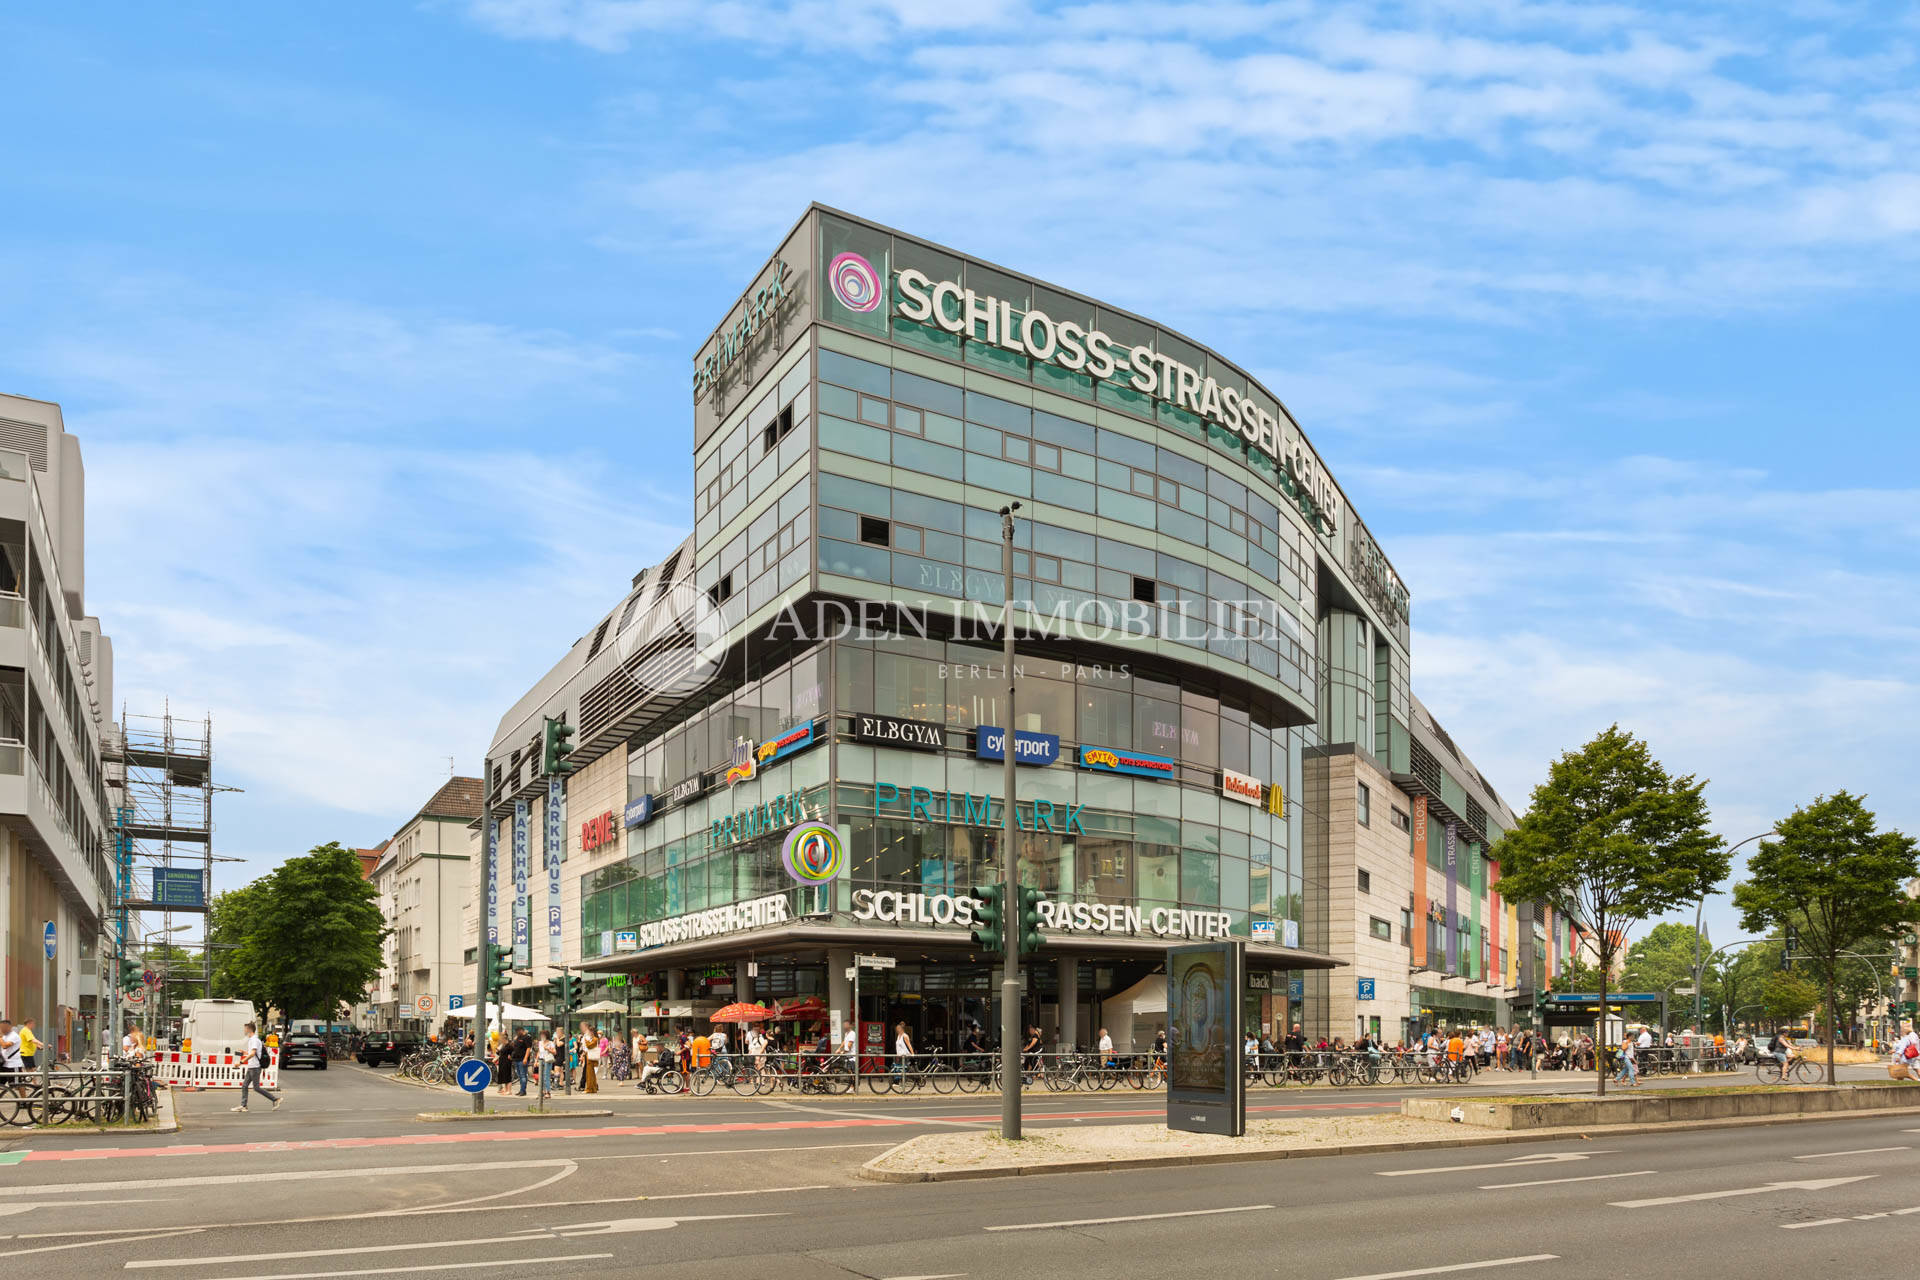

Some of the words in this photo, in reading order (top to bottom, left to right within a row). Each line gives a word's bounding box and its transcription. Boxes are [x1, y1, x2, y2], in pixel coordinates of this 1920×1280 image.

[897, 269, 1337, 532] SCHLOSS-STRASSEN-CENTER
[862, 717, 942, 746] ELBGYM
[1086, 751, 1117, 767] SMYTHS
[549, 782, 560, 894] PARKHAUS
[582, 810, 613, 852] REWE
[712, 786, 807, 849] PRIMARK
[1415, 798, 1425, 842] SCHLOSS
[516, 804, 526, 907] PARKHAUS
[1447, 824, 1456, 866] STRASSEN
[640, 894, 788, 947] SCHLOSS-STRASSEN-CENTER
[420, 999, 431, 1008] 30
